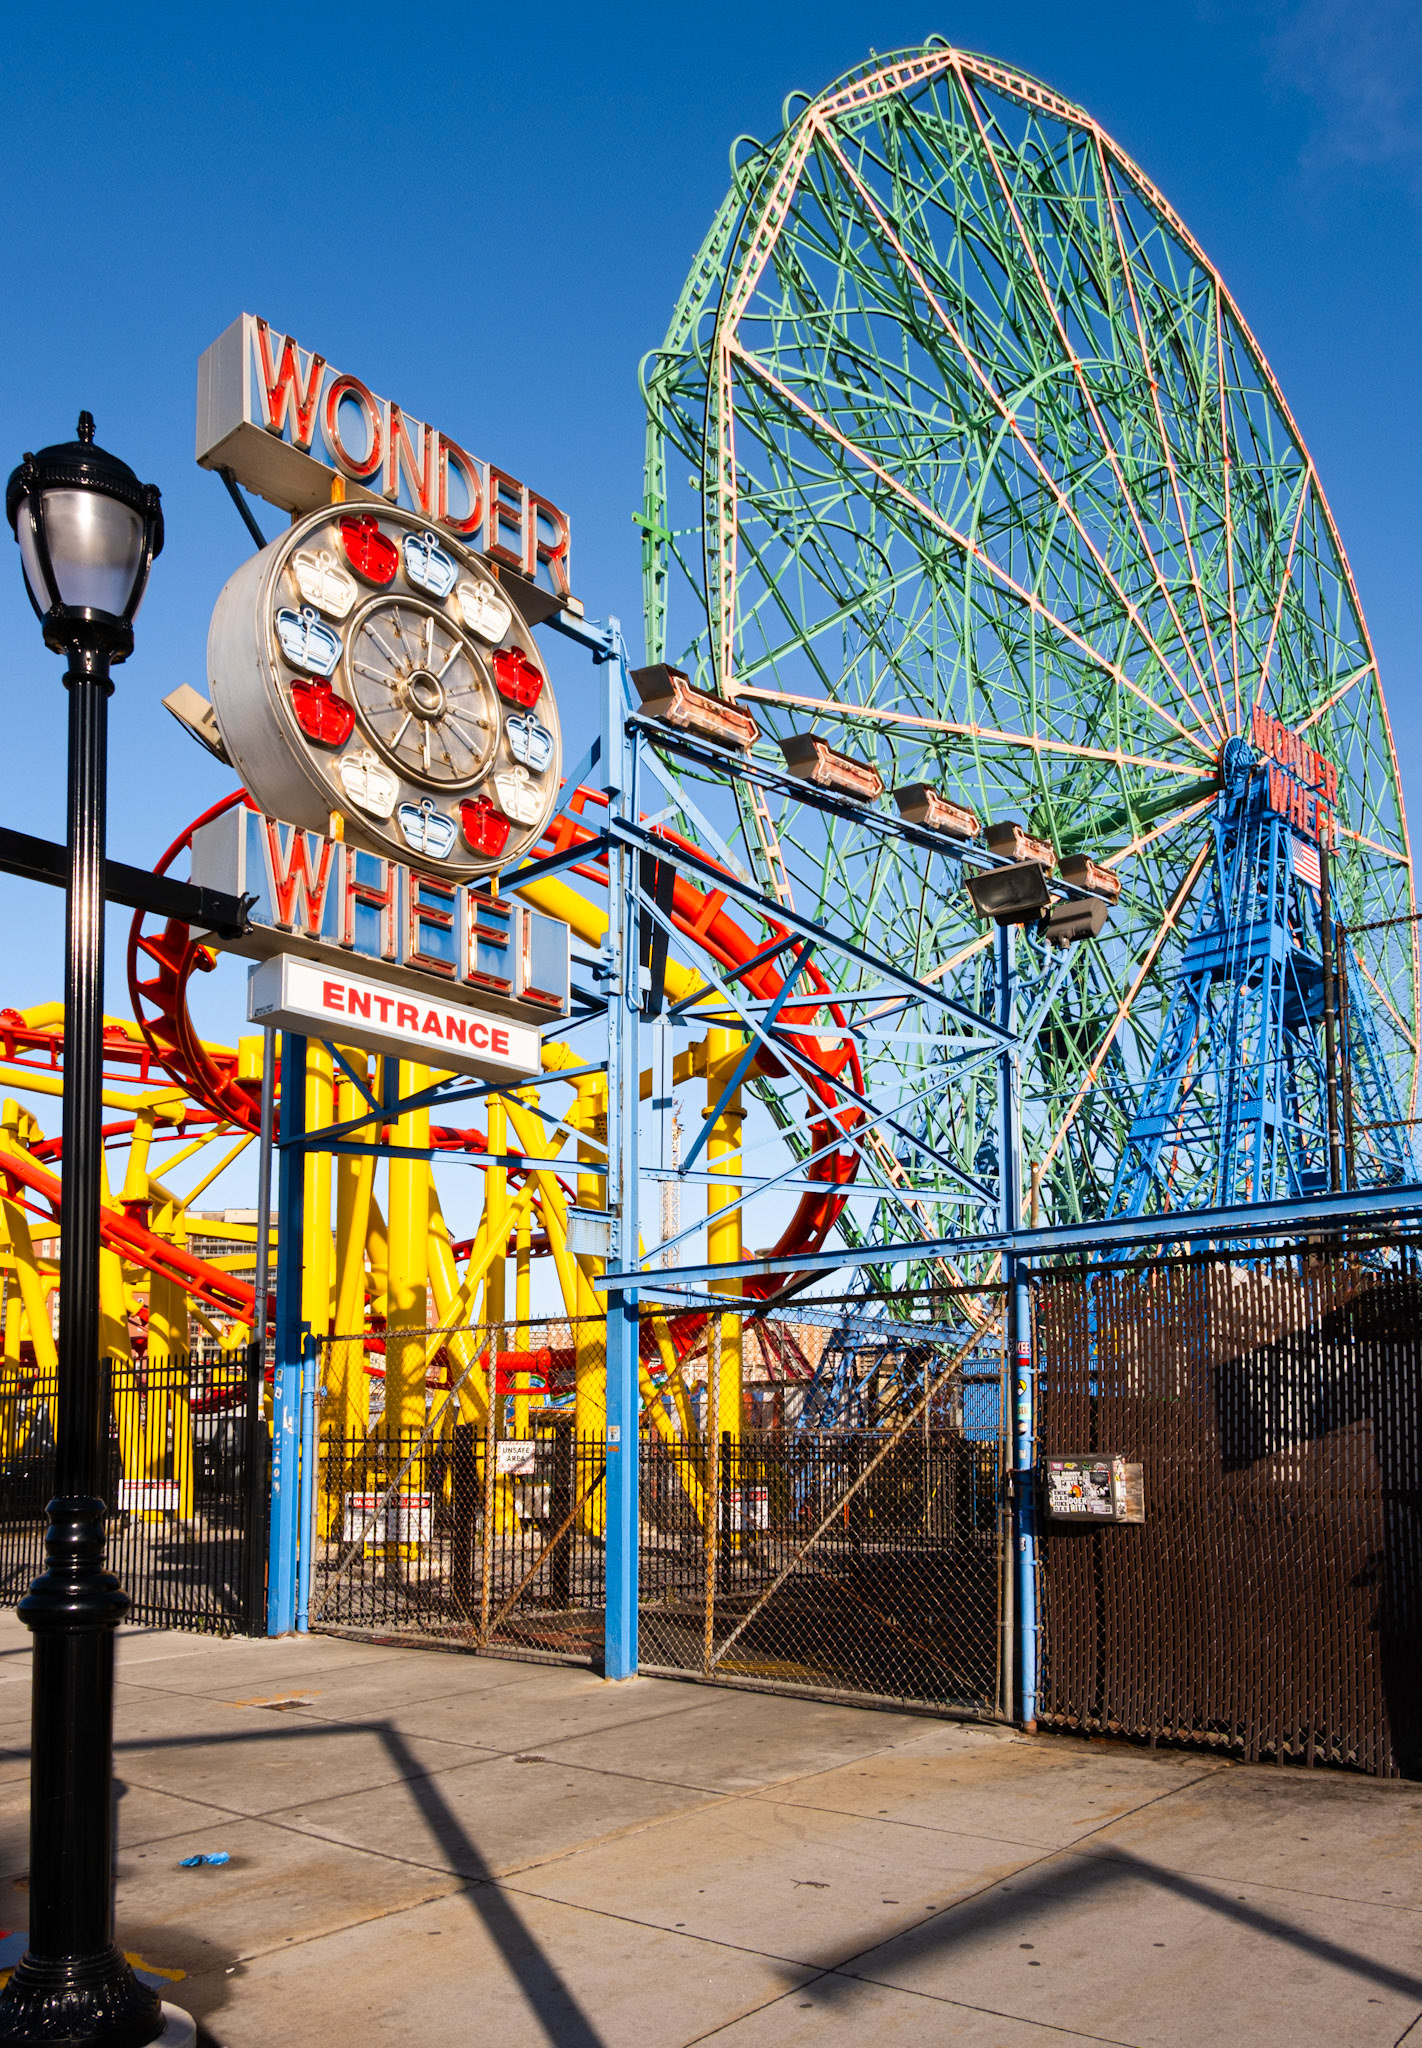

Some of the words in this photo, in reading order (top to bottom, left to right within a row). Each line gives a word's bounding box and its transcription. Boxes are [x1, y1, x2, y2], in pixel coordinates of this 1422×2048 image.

[251, 314, 571, 599] WONDER
[1252, 703, 1338, 807] WONDER
[1268, 763, 1340, 857] WHEEL
[259, 814, 564, 1010] WHEEL
[322, 980, 510, 1056] ENTRANCE
